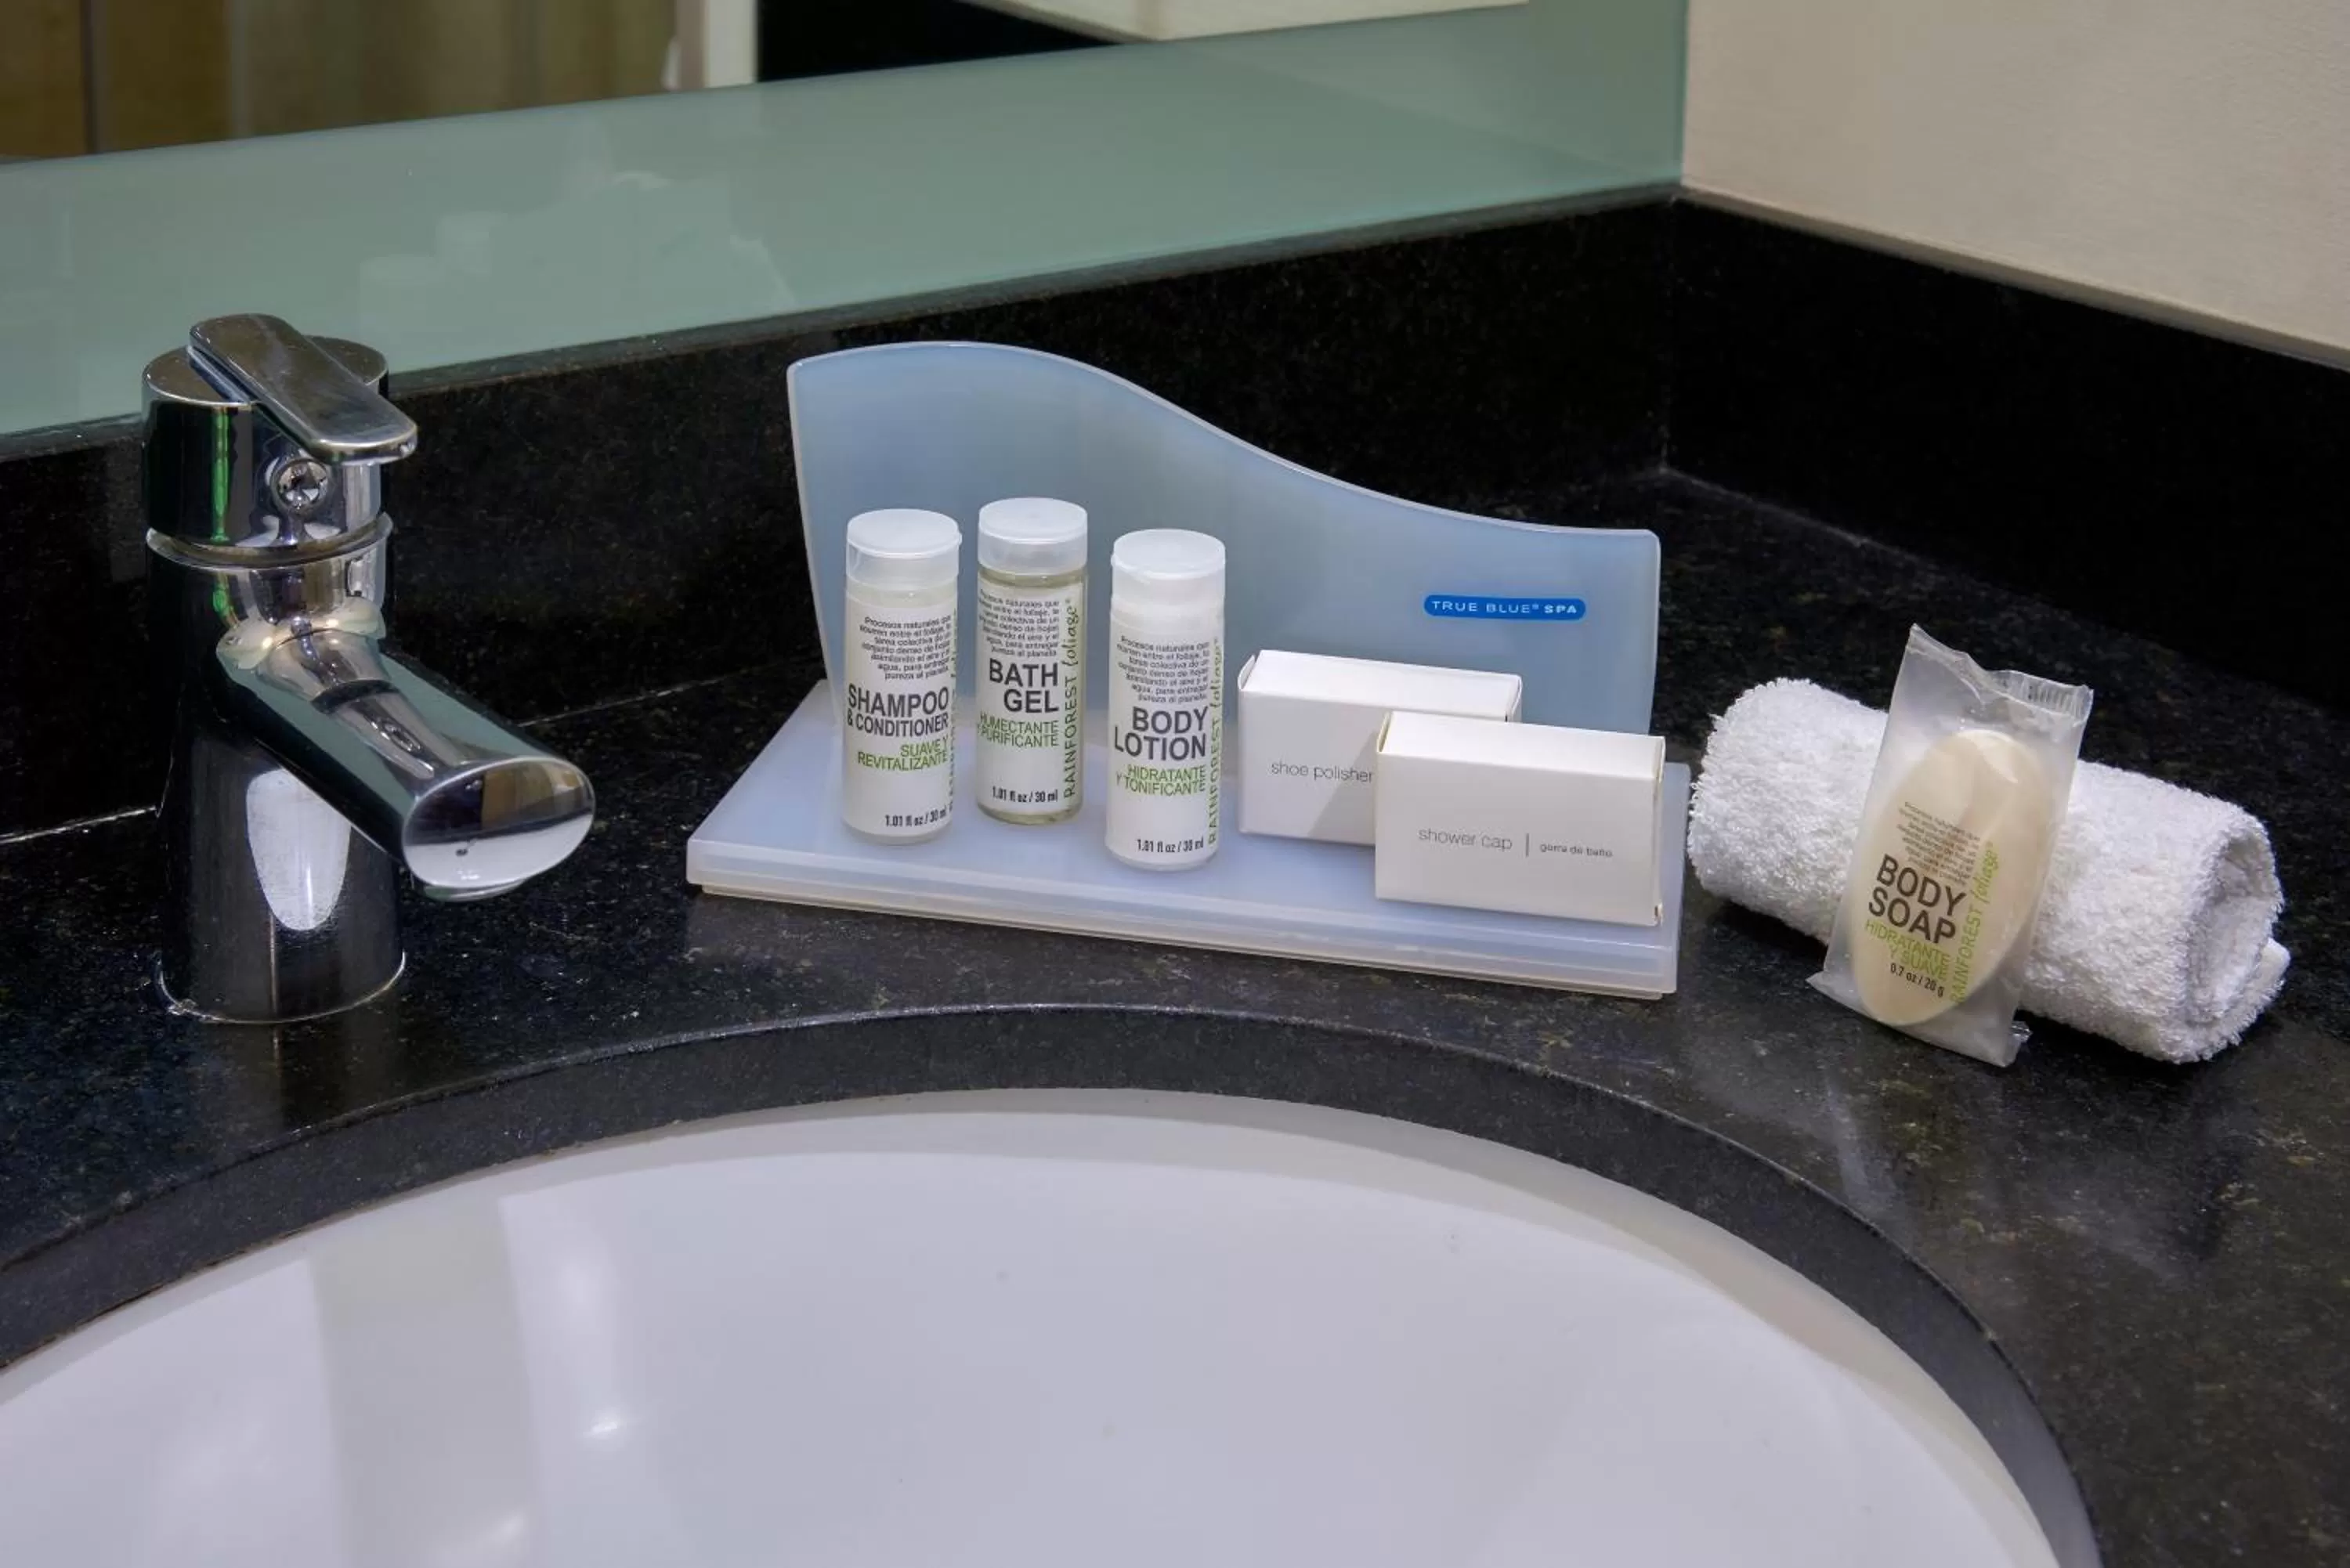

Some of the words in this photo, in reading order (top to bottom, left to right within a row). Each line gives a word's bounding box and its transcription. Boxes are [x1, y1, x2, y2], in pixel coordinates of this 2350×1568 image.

[1432, 601, 1478, 612] TRUE
[1544, 604, 1577, 613] SPA
[989, 658, 1058, 688] BATH
[848, 683, 949, 717] SHAMPOO
[1003, 688, 1059, 714] GEL
[847, 709, 853, 727] &
[855, 712, 949, 737] CONDITIONER
[980, 710, 1059, 735] HUMECTANTE
[1133, 706, 1208, 734] BODY
[900, 739, 941, 757] SUAVE
[942, 735, 949, 750] Y
[982, 725, 1060, 748] PURIFICANTE
[1064, 676, 1077, 799] RAINFOREST
[1115, 725, 1207, 761] LOTION
[858, 751, 948, 771] REVITALIZANTE
[1128, 764, 1206, 782] HIDRATANTE
[1271, 761, 1309, 776] shoe
[1314, 765, 1374, 783] polisher
[992, 786, 1007, 800] 1.01
[1010, 789, 1015, 802] fl
[1018, 793, 1027, 803] oz
[1035, 791, 1046, 803] 30
[1047, 789, 1058, 802] ml
[1116, 772, 1122, 786] Y
[1124, 778, 1206, 797] TONIFICANTE
[1209, 719, 1220, 845] RAINFOREST
[885, 815, 902, 827] 1.01
[914, 816, 924, 826] oz
[930, 809, 938, 822] 30
[1137, 839, 1154, 852] 1.01
[1157, 840, 1162, 852] fl
[1166, 844, 1175, 854] oz
[1184, 840, 1192, 851] 30
[1419, 828, 1476, 846] shower
[1482, 835, 1513, 852] cap
[1877, 854, 1967, 916] BODY
[1868, 887, 1956, 944] SOAP
[1864, 919, 1950, 966] HIDRATANTE
[1950, 904, 1983, 1003] RAINFOREST
[1900, 950, 1948, 981] SUAVE
[1890, 963, 1904, 977] 0.7
[1907, 972, 1918, 983] oz
[1925, 977, 1937, 991] 20
[1937, 986, 1945, 998] g
